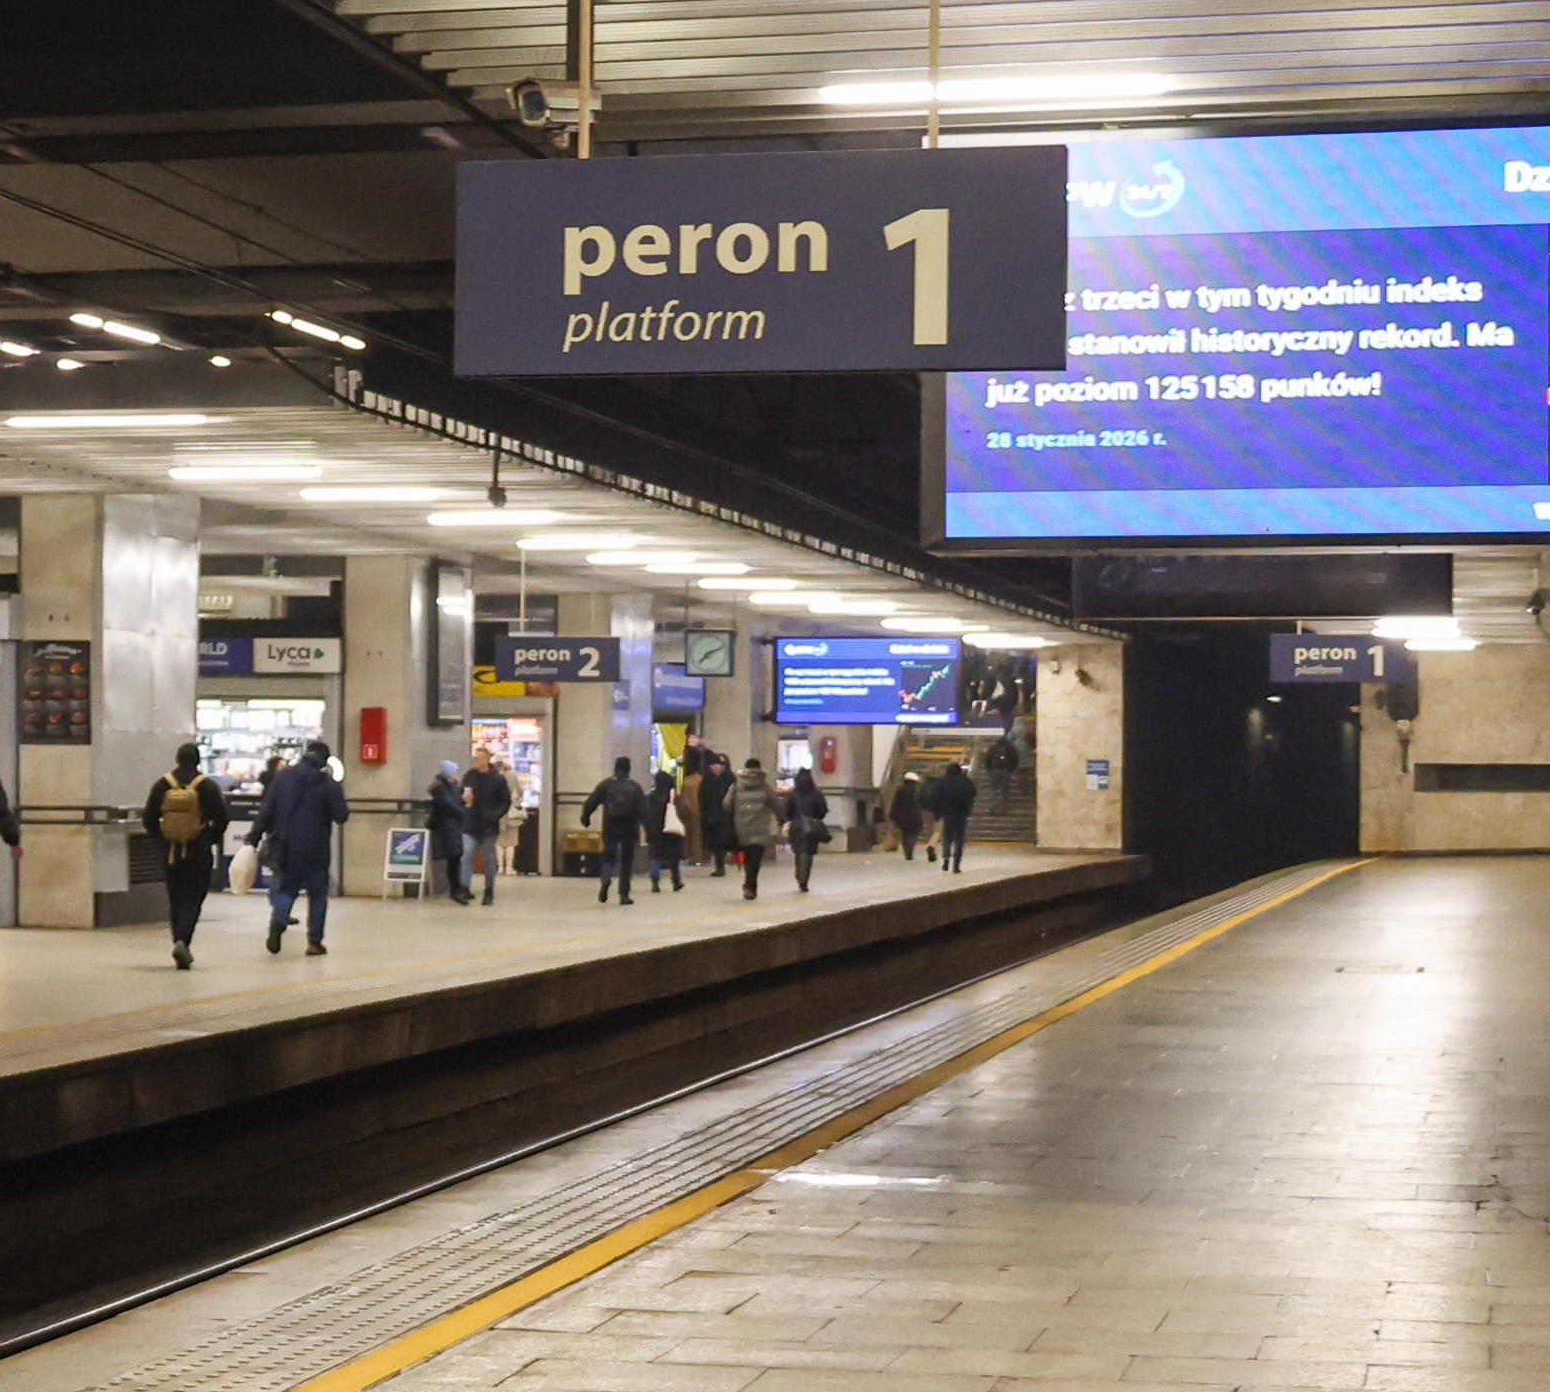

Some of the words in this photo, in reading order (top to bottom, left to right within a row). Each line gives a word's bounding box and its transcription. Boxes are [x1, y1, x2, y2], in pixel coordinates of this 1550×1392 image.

[563, 220, 828, 295] peron
[883, 208, 950, 345] 1
[1081, 284, 1160, 311] trzeci
[1165, 289, 1192, 309] w
[1195, 286, 1251, 313] tym
[1254, 278, 1381, 311] tygodniu
[1386, 275, 1483, 303] indeks
[562, 299, 766, 353] platform
[1067, 329, 1186, 355] stanowił
[1190, 327, 1354, 356] historyczny
[1358, 321, 1460, 349] rekord.
[1466, 322, 1515, 347] Ma
[984, 378, 1030, 408] już
[1035, 375, 1139, 407] poziom
[1260, 371, 1382, 403] punków!
[987, 432, 1012, 448] 28
[1015, 430, 1096, 450] stycznia
[1099, 430, 1149, 447] 2026
[1153, 432, 1167, 446] r.
[267, 644, 311, 661] Lyca
[514, 647, 571, 664] peron
[578, 647, 600, 677] 2
[1294, 647, 1357, 664] peron
[1367, 646, 1384, 676] 1
